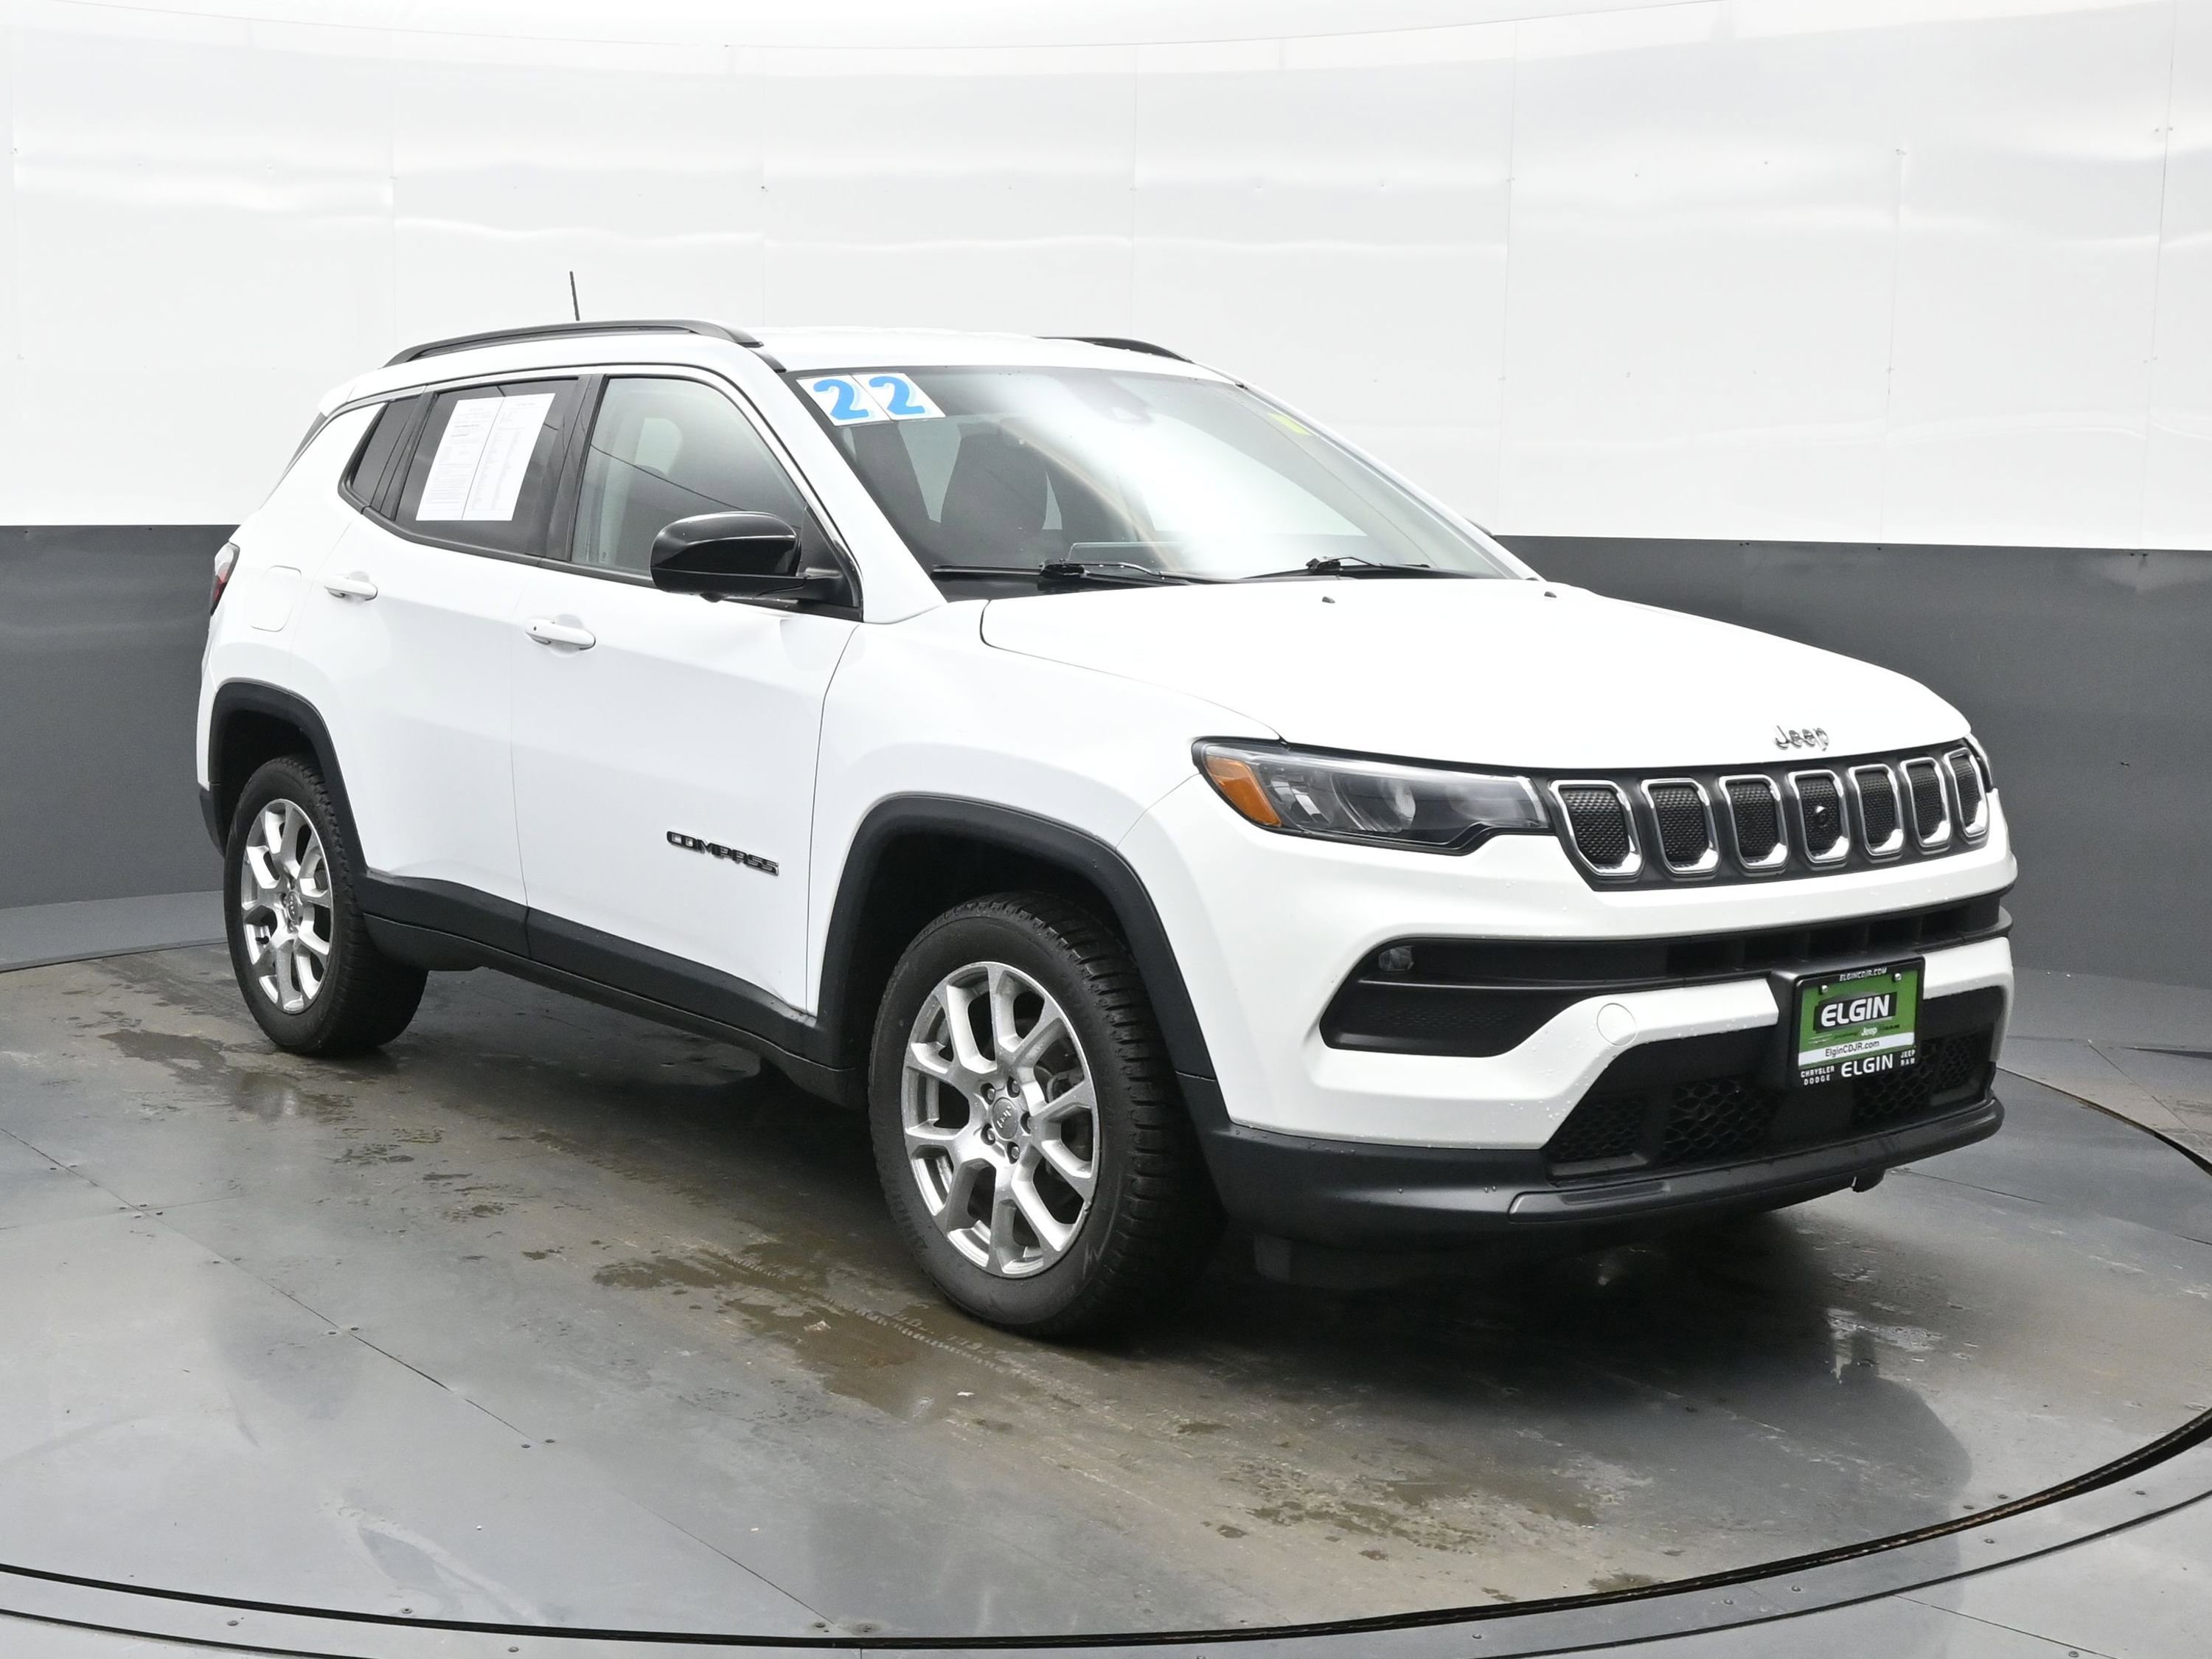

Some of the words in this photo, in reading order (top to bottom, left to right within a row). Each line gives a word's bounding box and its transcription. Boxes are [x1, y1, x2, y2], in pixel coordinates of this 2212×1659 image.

[1775, 725, 1829, 752] Jeep
[667, 830, 779, 876] COMPASS
[1821, 995, 1890, 1026] ELGIN
[1861, 1026, 1878, 1037] Jeep
[1825, 1040, 1880, 1058] ElginCDJR.com
[1901, 1049, 1916, 1058] JEEP
[1801, 1065, 1834, 1078] CHRYSLER
[1841, 1054, 1893, 1078] ELGIN
[1804, 1074, 1830, 1085] DODGE
